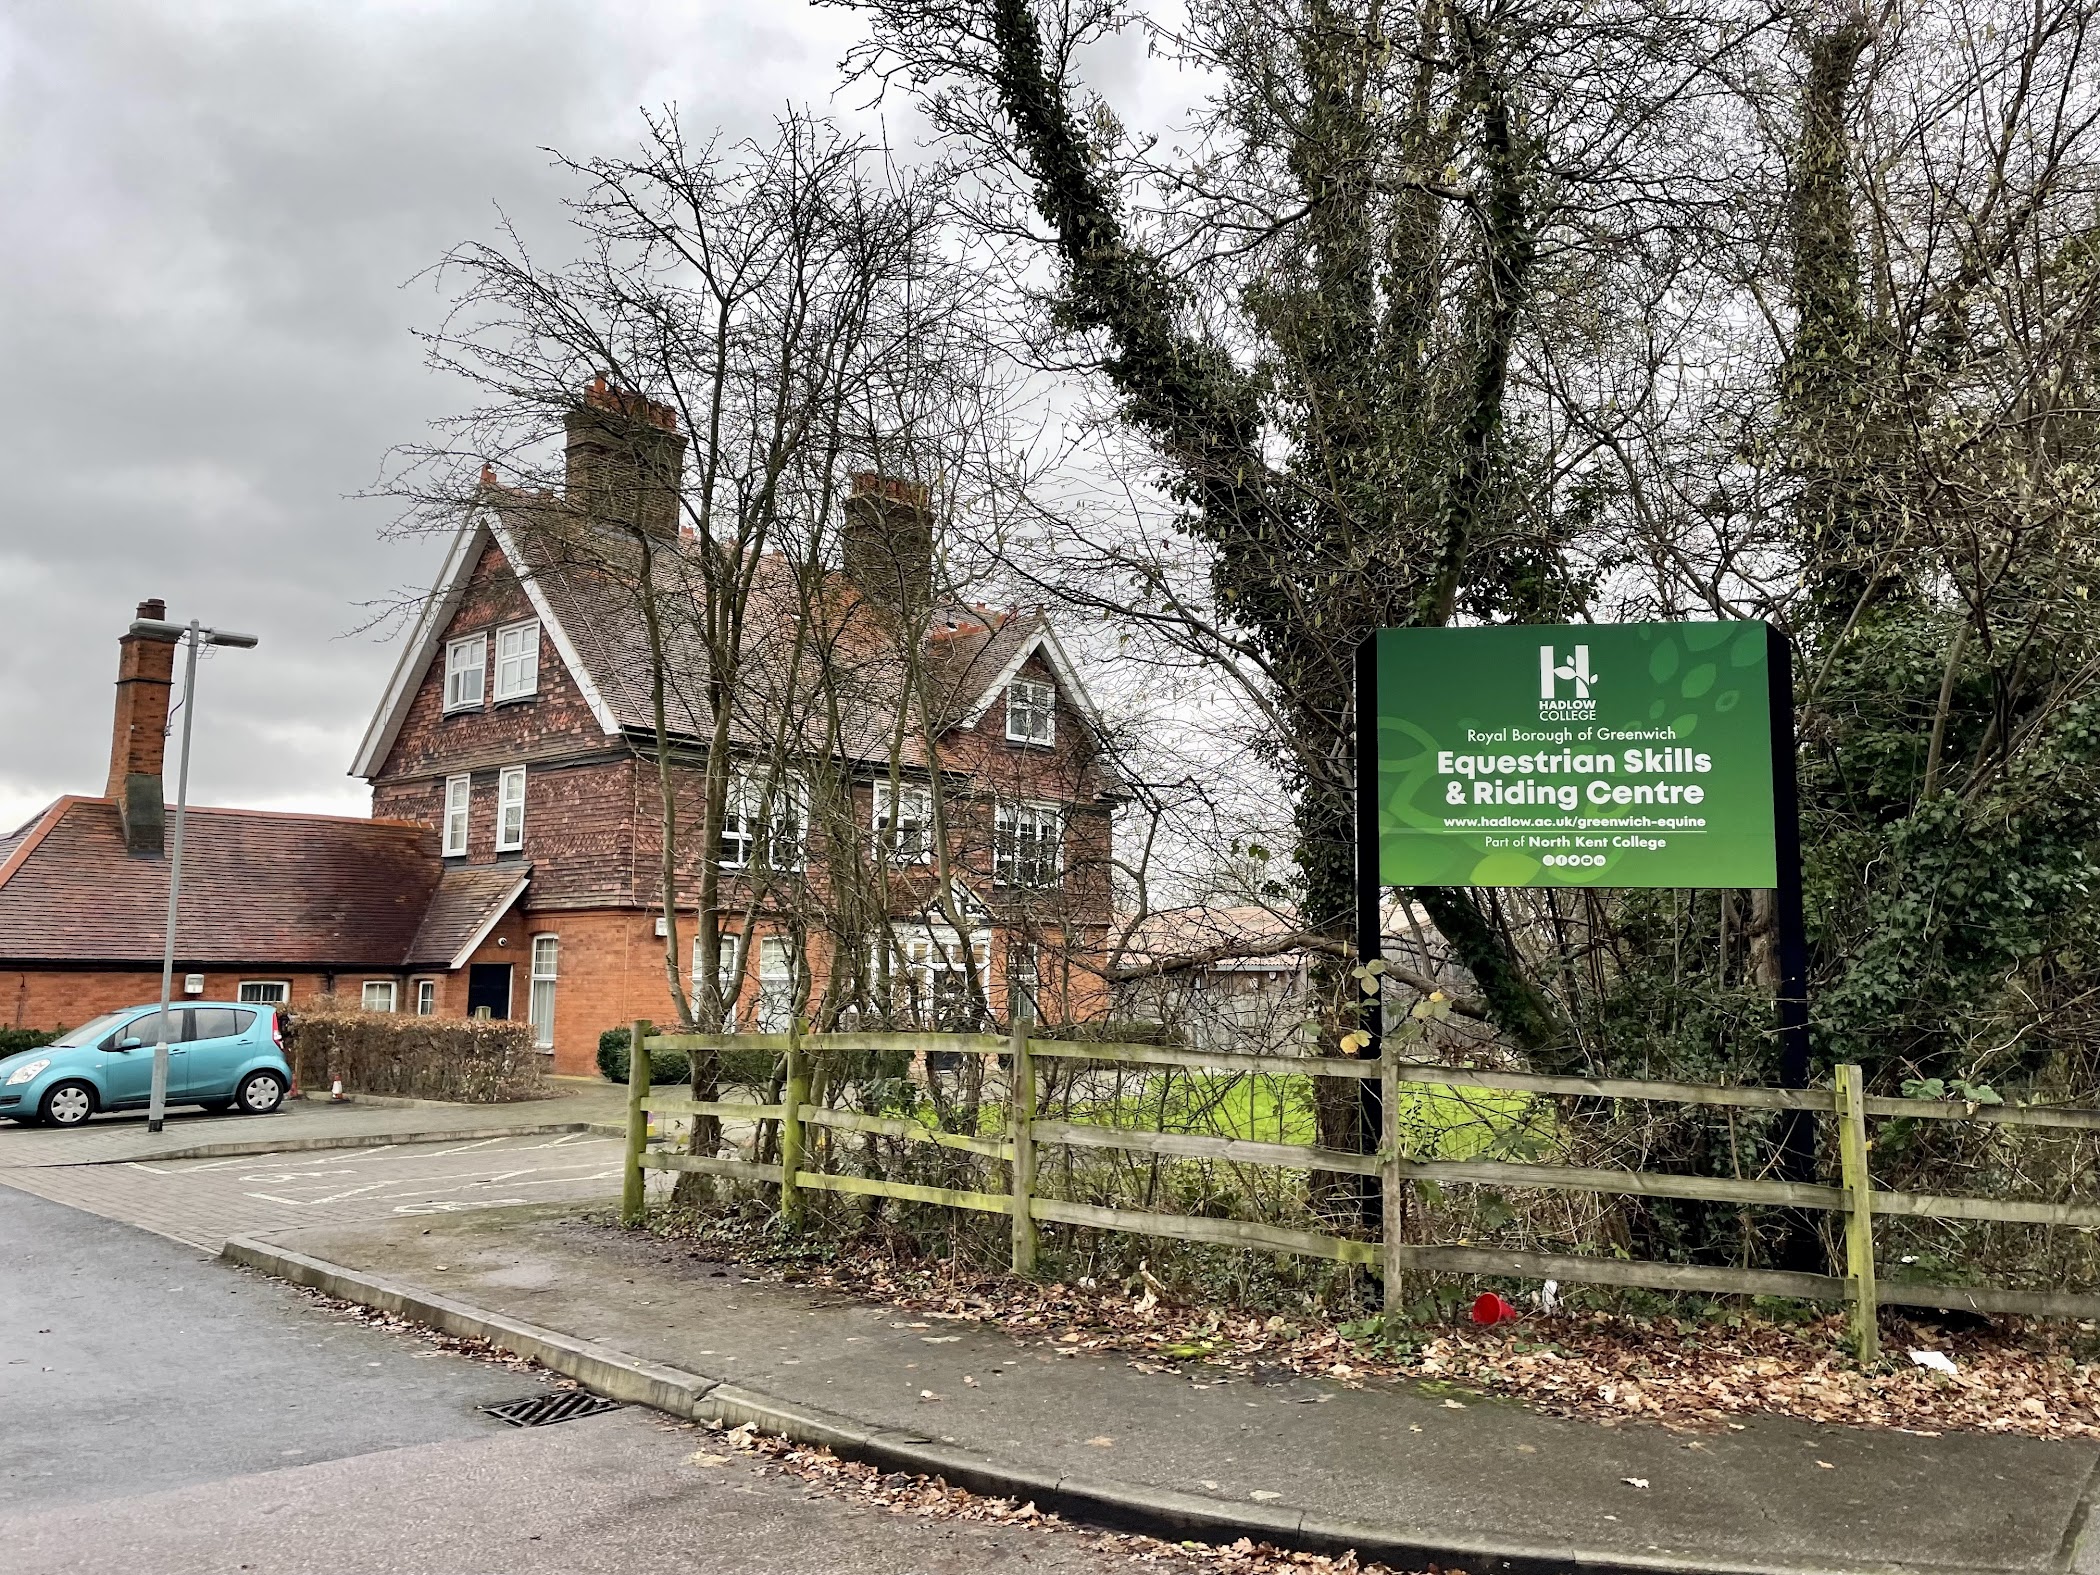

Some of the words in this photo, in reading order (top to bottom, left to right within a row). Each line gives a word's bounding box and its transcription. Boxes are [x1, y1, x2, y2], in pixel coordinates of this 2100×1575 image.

[1540, 699, 1596, 710] HADLOW
[1540, 710, 1596, 721] COLLEGE
[1467, 728, 1507, 745] Royal
[1512, 727, 1573, 745] Borough
[1578, 727, 1593, 741] of
[1597, 726, 1676, 741] Greenwich
[1437, 749, 1616, 779] Equestrian
[1624, 747, 1712, 774] Skills
[1446, 780, 1467, 805] &
[1474, 780, 1578, 810] Riding
[1587, 781, 1705, 805] Centre
[1443, 815, 1706, 829] www.hadlow.ac.uk/greenwich-equine
[1485, 836, 1509, 847] Part
[1513, 836, 1525, 848] of
[1528, 836, 1571, 848] North
[1575, 836, 1609, 848] Kent
[1613, 836, 1667, 850] College
